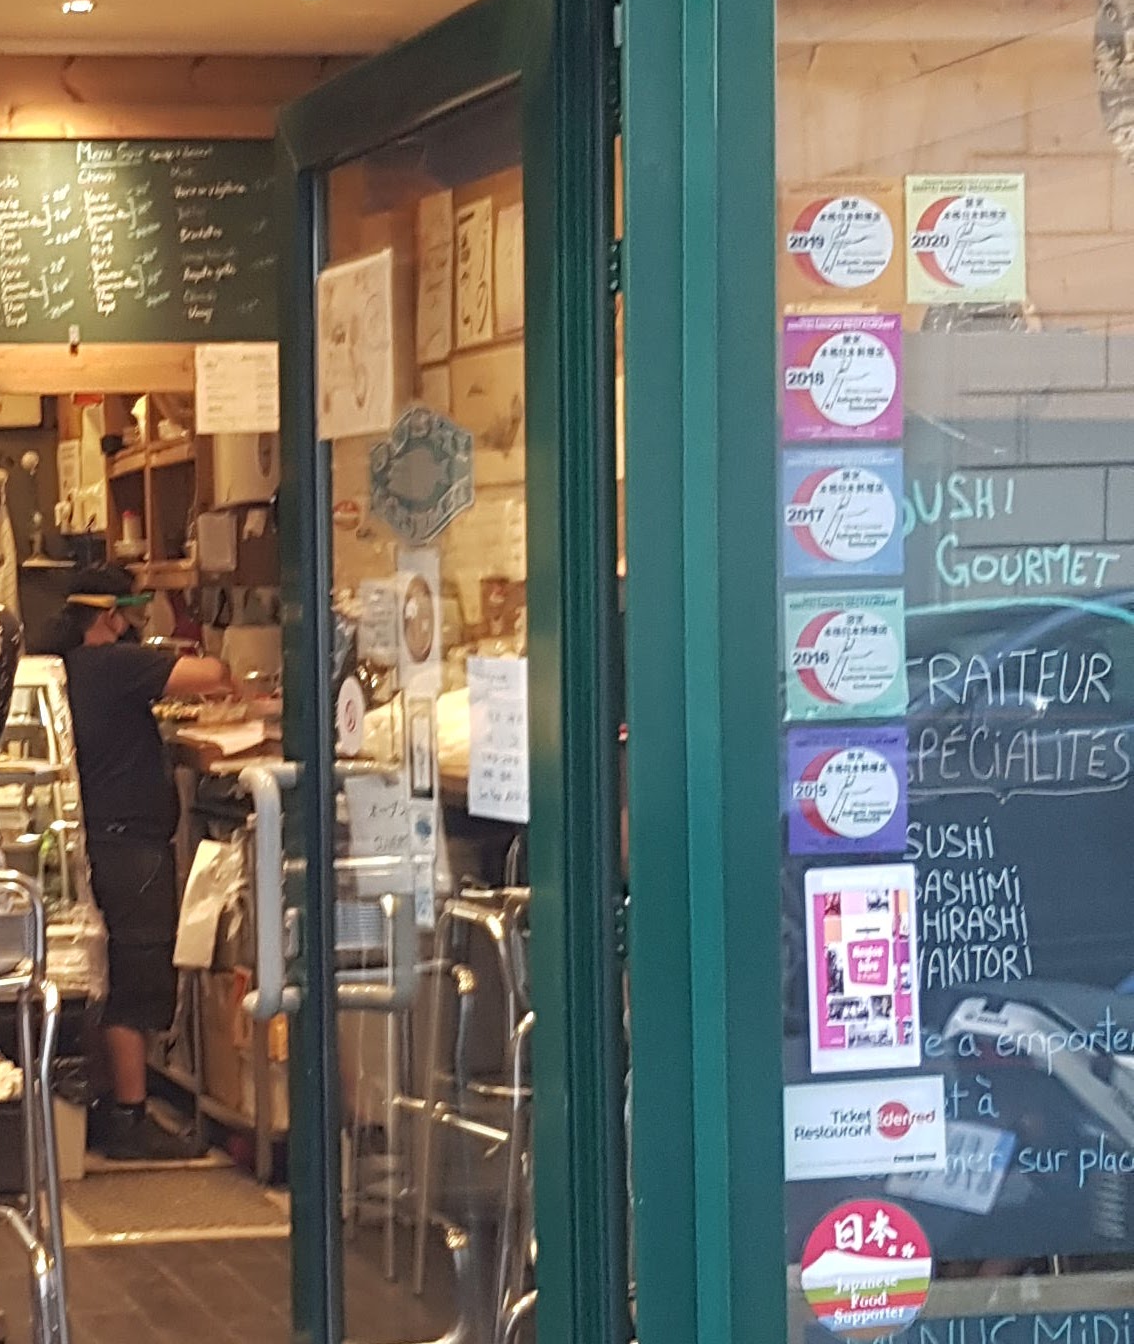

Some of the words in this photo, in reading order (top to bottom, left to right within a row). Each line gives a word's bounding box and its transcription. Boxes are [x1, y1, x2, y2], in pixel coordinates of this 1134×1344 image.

[789, 235, 825, 249] 2019
[911, 235, 950, 249] 2020
[787, 371, 825, 386] 2018
[787, 508, 824, 523] 2017
[936, 532, 1121, 589] GOURMET
[793, 652, 830, 666] 2016
[907, 727, 1131, 783] PÉCIALITÉS
[795, 784, 828, 799] 2015
[917, 904, 1029, 944] HIRASHI
[831, 1108, 871, 1124] Ticket
[794, 1123, 871, 1140] Restaurant
[1019, 1146, 1069, 1174] sur
[834, 1208, 898, 1252] 日本
[834, 1274, 899, 1296] Japanese
[851, 1291, 888, 1310] Food
[833, 1307, 905, 1327] Supporter
